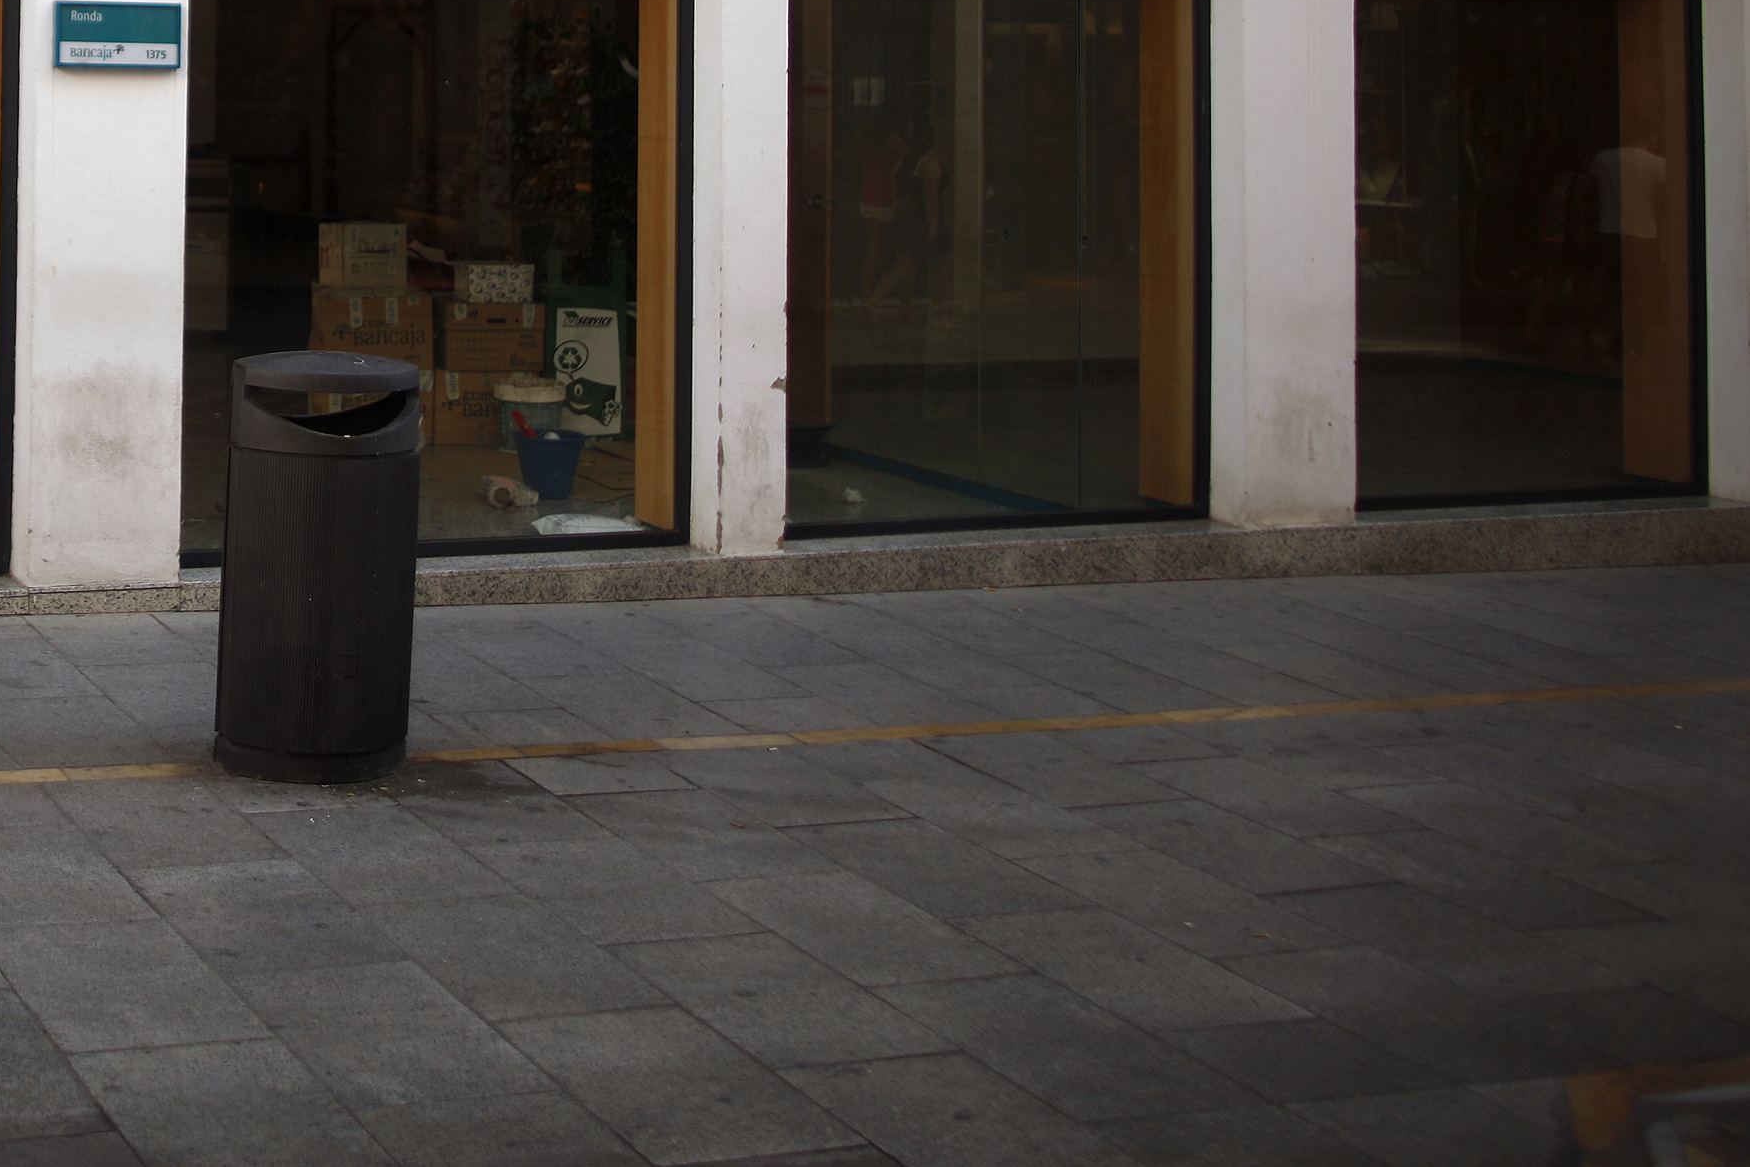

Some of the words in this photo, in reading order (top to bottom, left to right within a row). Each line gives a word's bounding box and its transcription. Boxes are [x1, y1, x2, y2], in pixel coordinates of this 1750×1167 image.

[70, 9, 103, 22] Ronda
[70, 44, 113, 61] Bancaja
[145, 49, 167, 60] 1375
